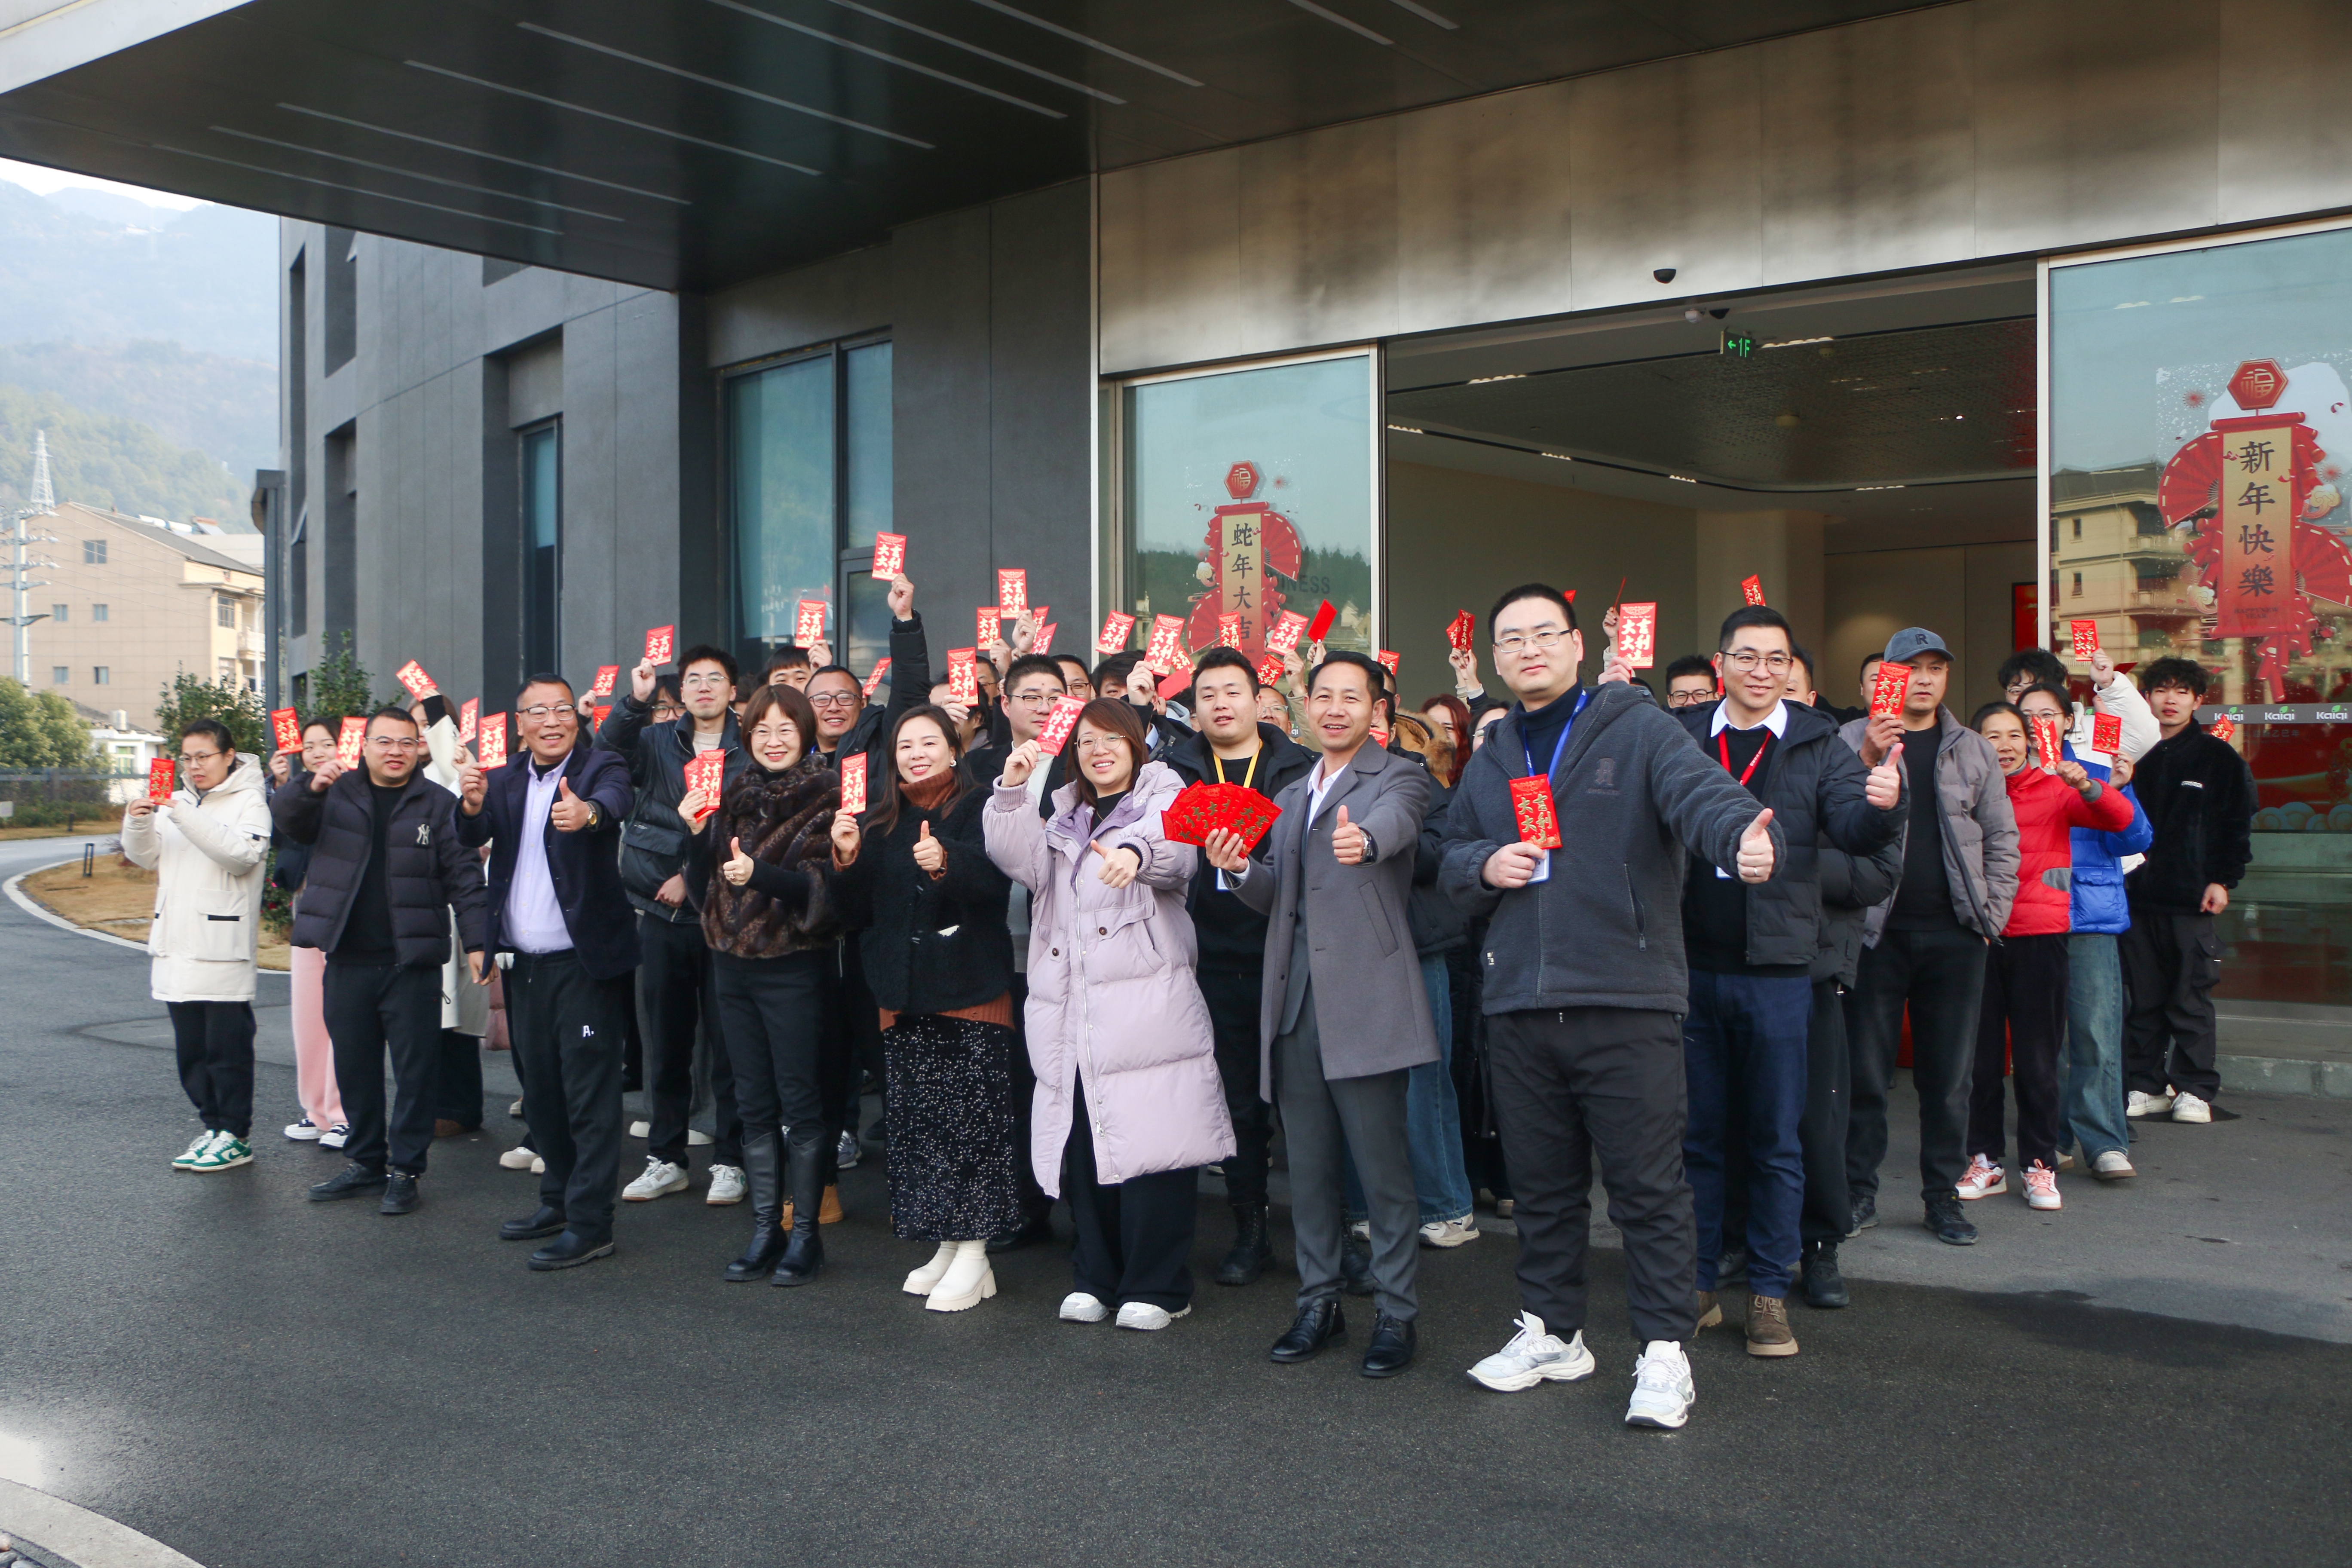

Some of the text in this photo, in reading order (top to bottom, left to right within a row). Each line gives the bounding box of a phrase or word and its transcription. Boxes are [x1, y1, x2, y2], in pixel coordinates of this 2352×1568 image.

[1739, 338, 1751, 357] 1F
[2238, 441, 2275, 597] 新年快樂
[1915, 634, 1928, 645] R
[2264, 708, 2295, 721] Kaiqi
[2316, 707, 2348, 720] Kaiqi
